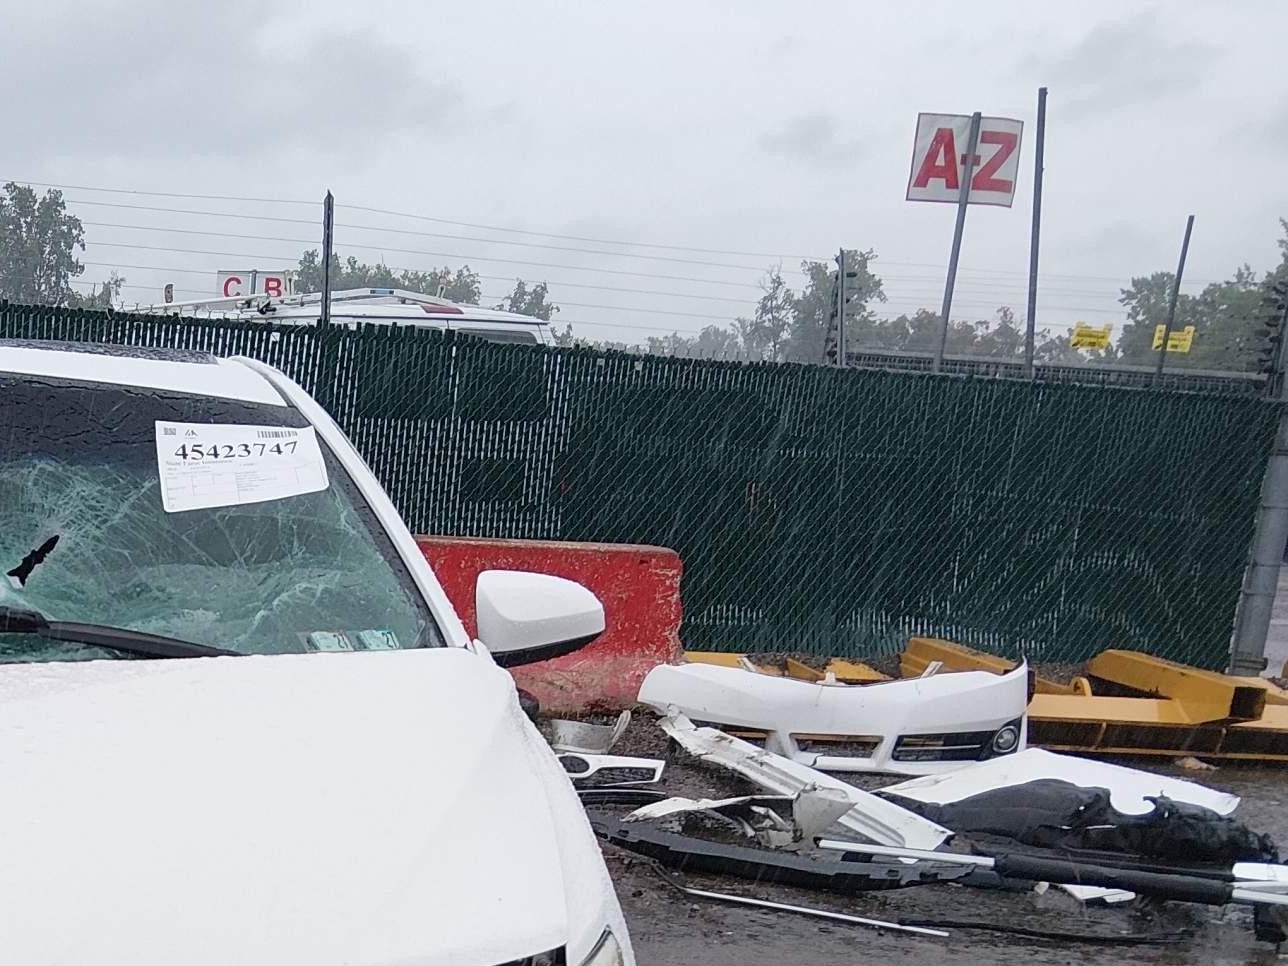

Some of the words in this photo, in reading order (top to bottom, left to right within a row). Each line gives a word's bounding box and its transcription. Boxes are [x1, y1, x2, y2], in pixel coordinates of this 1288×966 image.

[913, 128, 1018, 194] A-Z
[223, 276, 242, 298] C
[264, 277, 282, 298] B
[174, 440, 298, 461] 45423747
